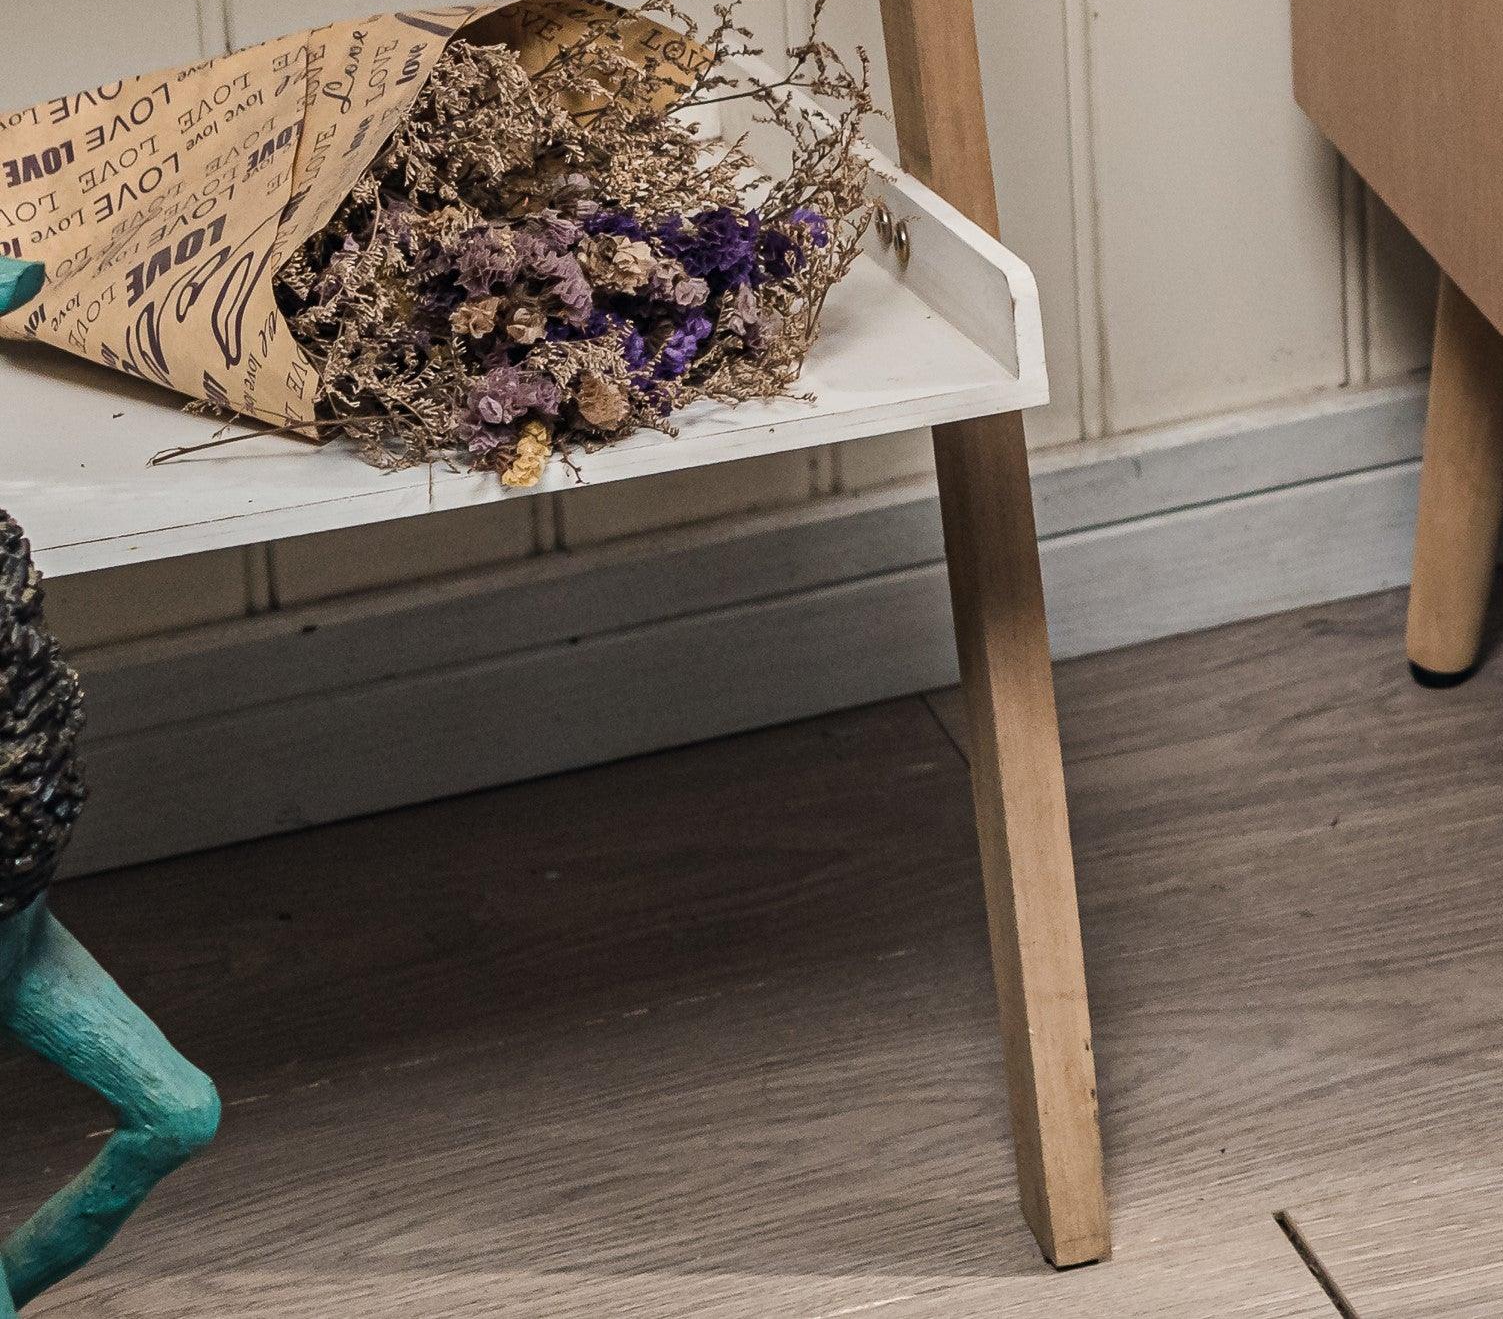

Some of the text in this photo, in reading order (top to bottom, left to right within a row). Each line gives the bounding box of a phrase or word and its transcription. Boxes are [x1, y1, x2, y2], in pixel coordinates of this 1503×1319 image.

[178, 72, 251, 135] LOVE
[365, 39, 399, 107] LOVE
[86, 82, 171, 153] LOVE
[184, 120, 219, 152] love
[224, 89, 264, 123] love
[3, 139, 76, 189] LOVE
[78, 134, 161, 195] LOVE
[93, 151, 180, 224] LOVE
[30, 208, 86, 244] Love
[149, 182, 236, 248] LOVE
[125, 213, 228, 309] LOVE
[51, 291, 82, 333] love
